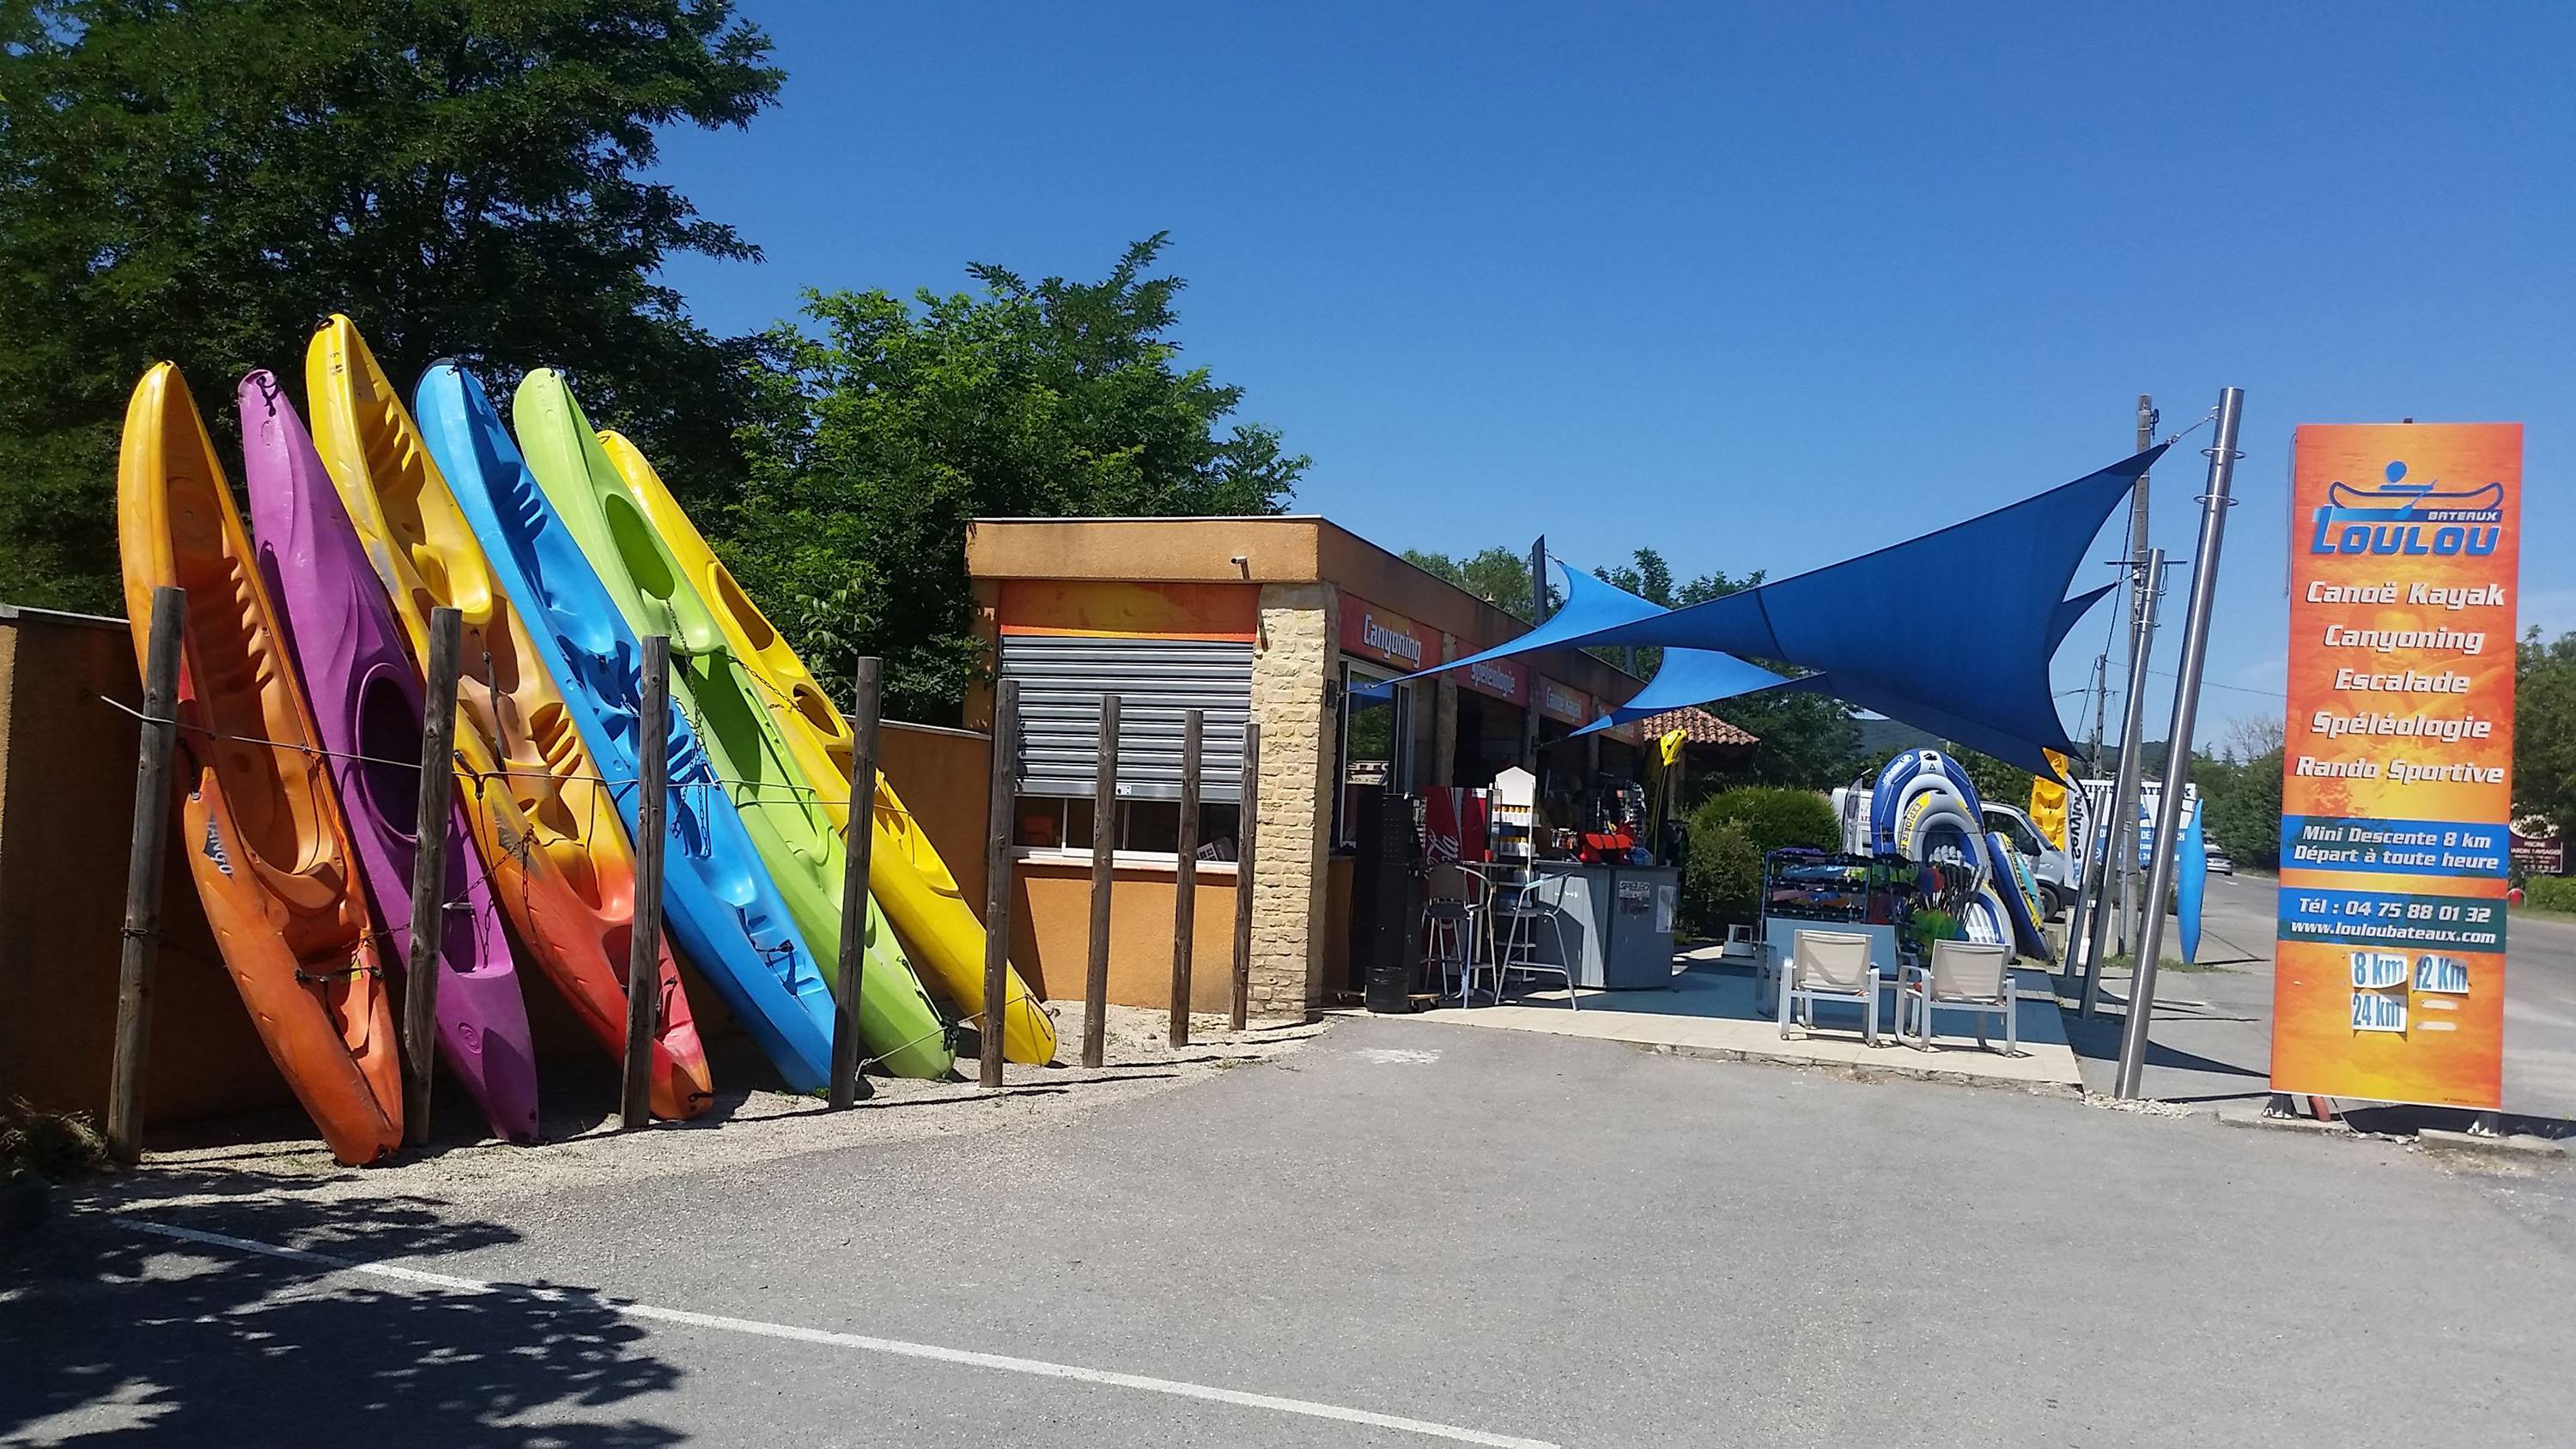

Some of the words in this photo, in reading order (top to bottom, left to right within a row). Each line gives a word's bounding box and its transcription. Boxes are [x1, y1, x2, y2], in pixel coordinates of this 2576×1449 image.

[2311, 505, 2500, 555] LOULOU
[2427, 510, 2497, 521] BATEAUX
[2306, 581, 2397, 603] Canoë
[2407, 583, 2506, 610] Kayak
[1363, 614, 1421, 669] Canyoning
[2324, 624, 2485, 654] Canyoning
[2335, 668, 2470, 694] Escalade
[2312, 710, 2491, 743] Spéléologie
[2295, 756, 2379, 779] Rando
[2388, 759, 2504, 785] Sportive
[1900, 803, 1923, 842] EXPLORER
[2302, 825, 2344, 842] Mini
[2348, 828, 2438, 846] Descente
[2443, 831, 2458, 847] 8
[2461, 833, 2491, 849] km
[2293, 845, 2360, 864] Départ
[2363, 847, 2377, 864] à
[2383, 851, 2436, 867] toute
[2440, 852, 2500, 870] heure
[2300, 898, 2328, 914] Tél
[2345, 900, 2372, 916] 04
[2378, 902, 2403, 918] 75
[2407, 904, 2433, 919] 88
[2439, 906, 2460, 921] 01
[2464, 907, 2492, 923] 32
[2291, 921, 2496, 943] www.louloubateaux.com
[2354, 952, 2366, 985] 8
[2372, 954, 2403, 985] km
[2415, 956, 2433, 990] 12
[2353, 994, 2372, 1026] 24
[2376, 996, 2400, 1028] km
